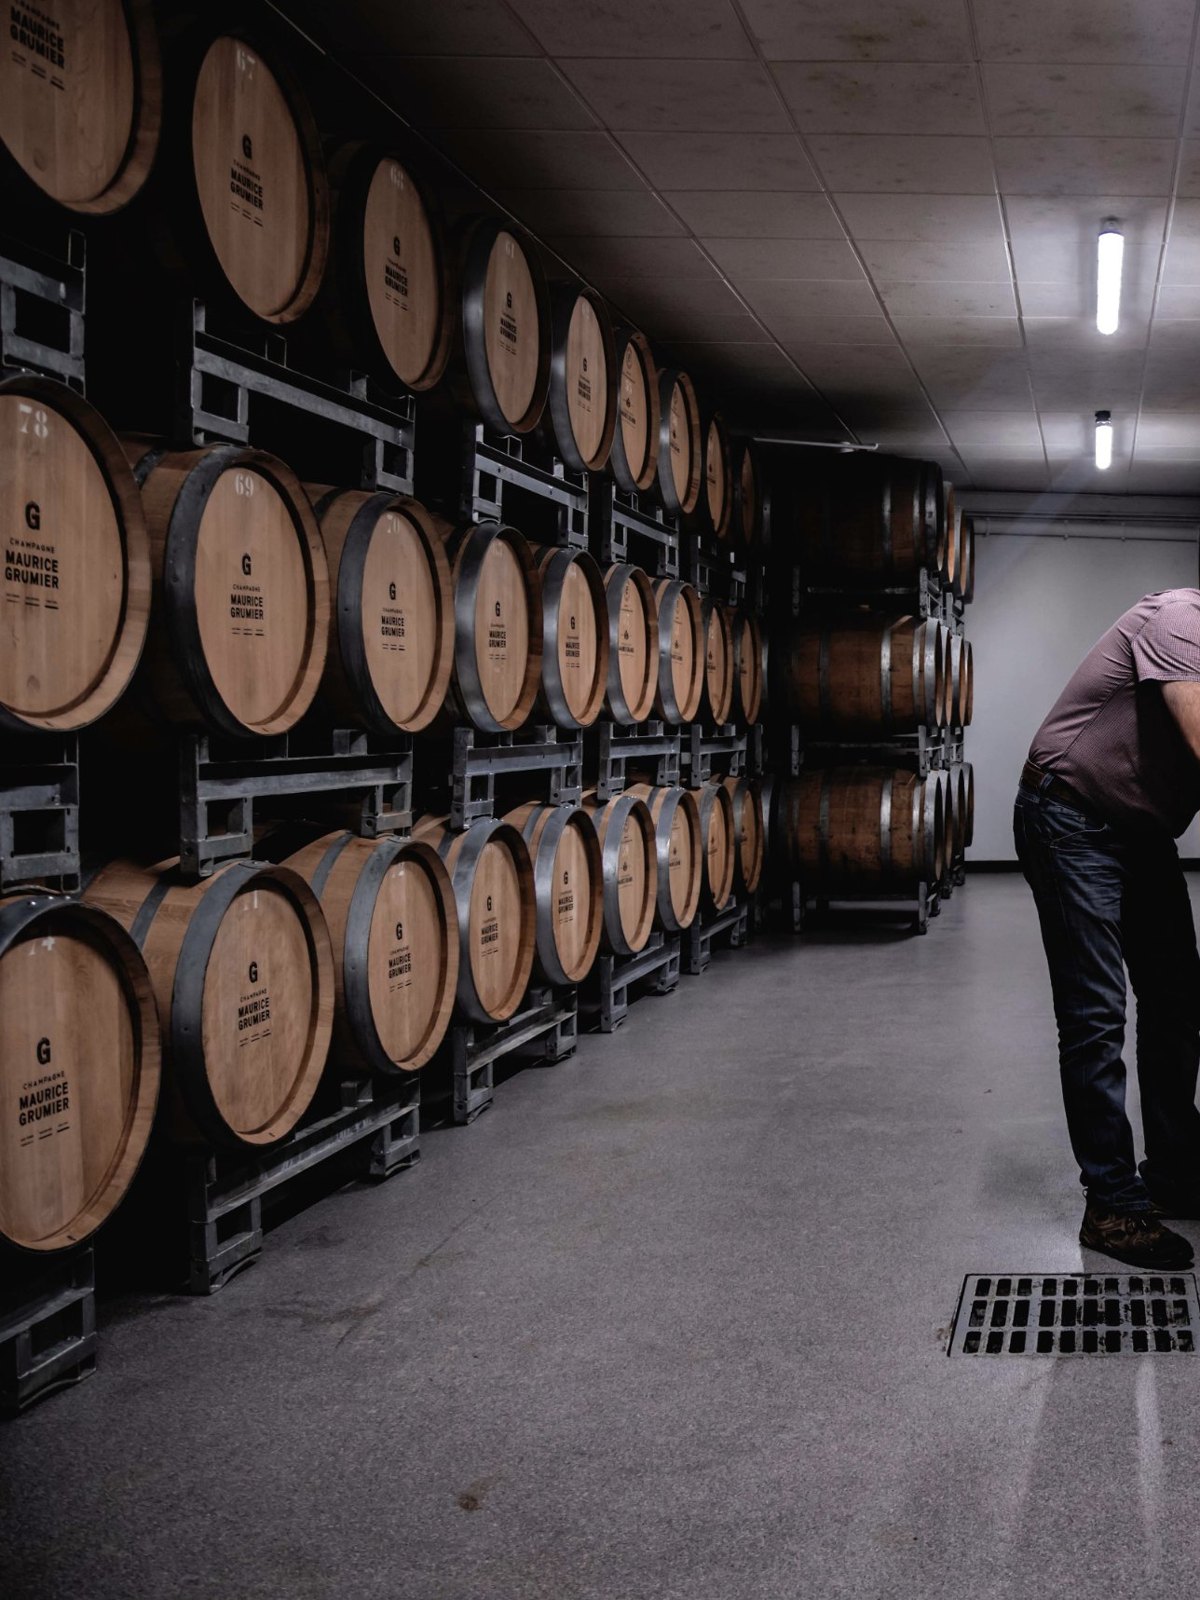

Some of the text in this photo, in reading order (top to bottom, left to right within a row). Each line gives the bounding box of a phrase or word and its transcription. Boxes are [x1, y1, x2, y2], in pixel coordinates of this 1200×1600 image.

[11, 6, 64, 52] MAURICE
[10, 24, 64, 69] GRUMIER
[242, 133, 252, 160] G
[231, 167, 263, 198] MAURICE
[230, 181, 263, 210] GRUMIER
[385, 264, 408, 287] MAURICE
[385, 275, 408, 297] GRUMIER
[18, 403, 49, 439] 78
[235, 473, 254, 497] 69
[24, 501, 40, 530] G
[9, 537, 55, 554] CHAMPAGNE
[5, 549, 59, 573] MAURICE
[242, 553, 252, 576] G
[4, 566, 59, 589] GRUMIER
[230, 593, 263, 608] MAURICE
[389, 582, 396, 600] G
[230, 606, 264, 620] GRUMIER
[381, 615, 405, 627] MAURICE
[381, 626, 405, 638] GRUMIER
[396, 922, 403, 940] G
[249, 961, 258, 983] G
[388, 953, 411, 968] MAURICE
[388, 963, 412, 979] GRUMIER
[238, 997, 270, 1018] MAURICE
[238, 1009, 271, 1031] GRUMIER
[36, 1037, 51, 1065] G
[22, 1070, 65, 1090] CHAMPAGNE
[19, 1081, 68, 1111] MAURICE
[18, 1097, 69, 1127] GRUMIER
